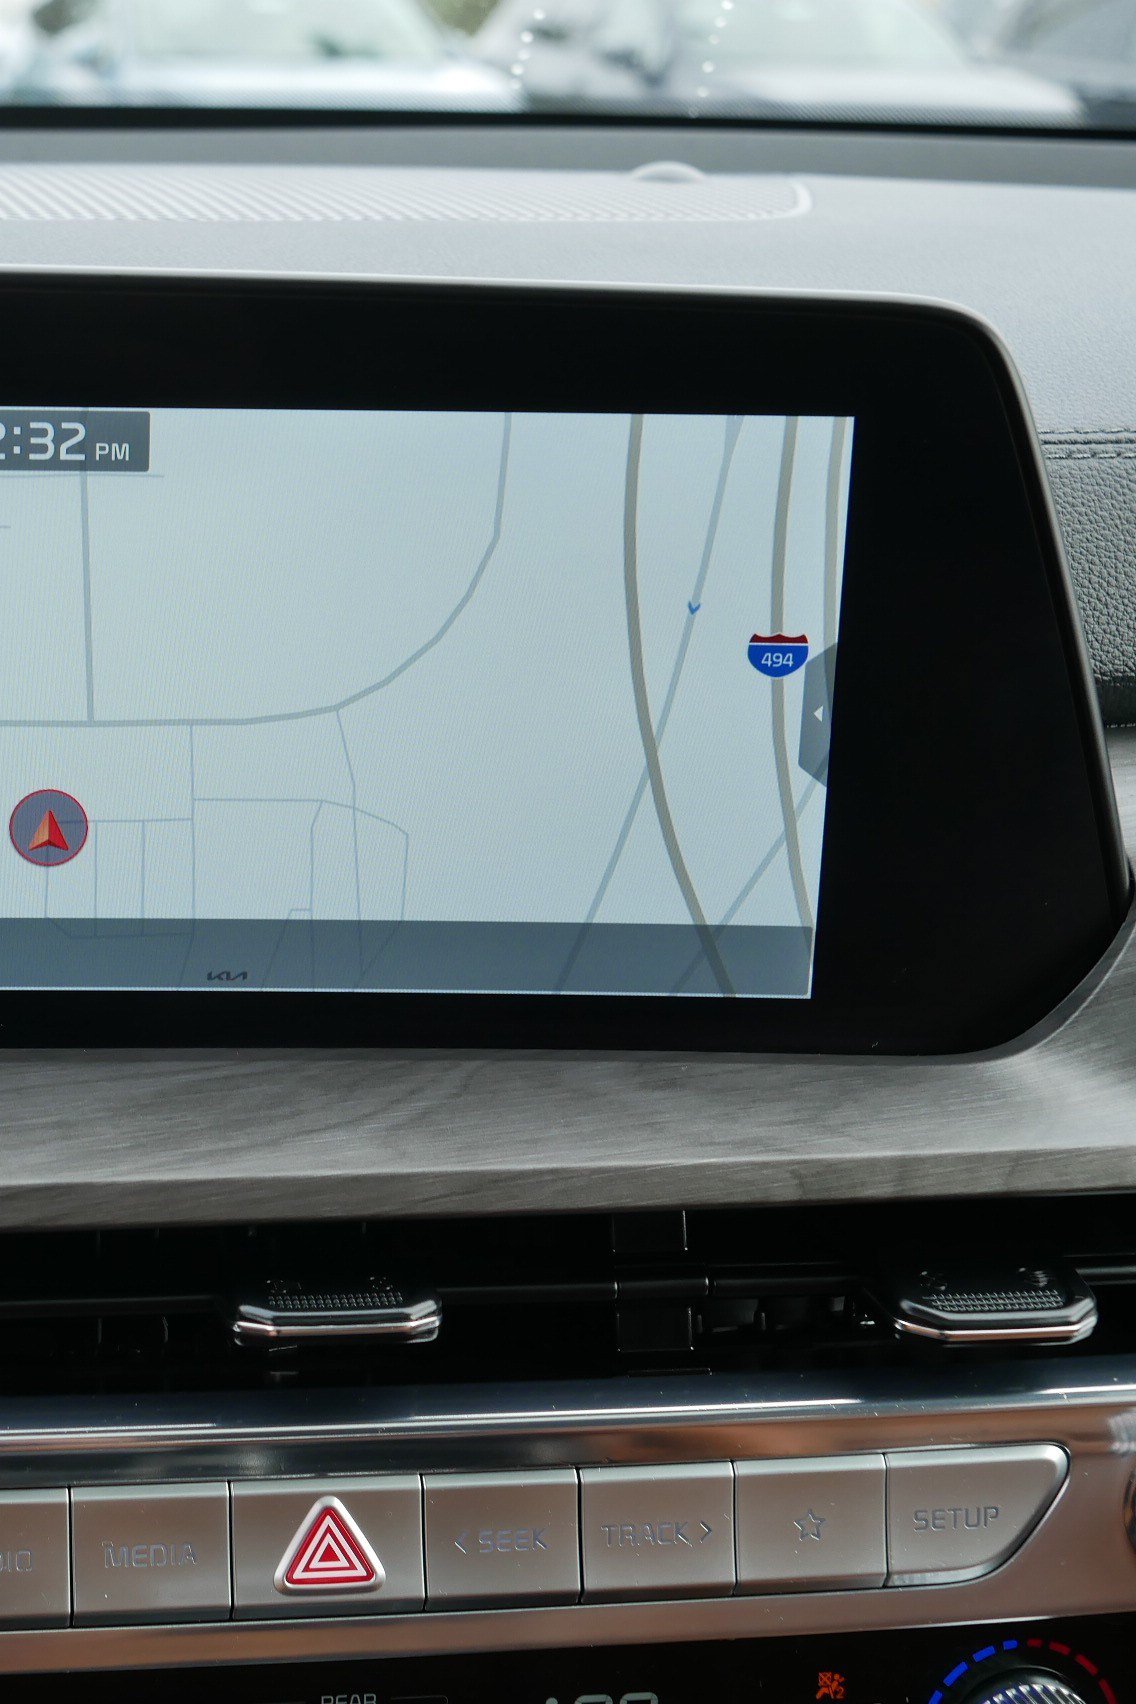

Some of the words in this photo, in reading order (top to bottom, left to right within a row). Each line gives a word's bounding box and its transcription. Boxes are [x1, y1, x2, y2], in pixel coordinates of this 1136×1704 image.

[95, 442, 130, 461] PM
[761, 652, 794, 668] 494
[913, 1506, 1000, 1532] SETUP
[478, 1527, 549, 1553] SEEK
[601, 1521, 693, 1548] TRACK
[102, 1542, 197, 1569] MEDIA
